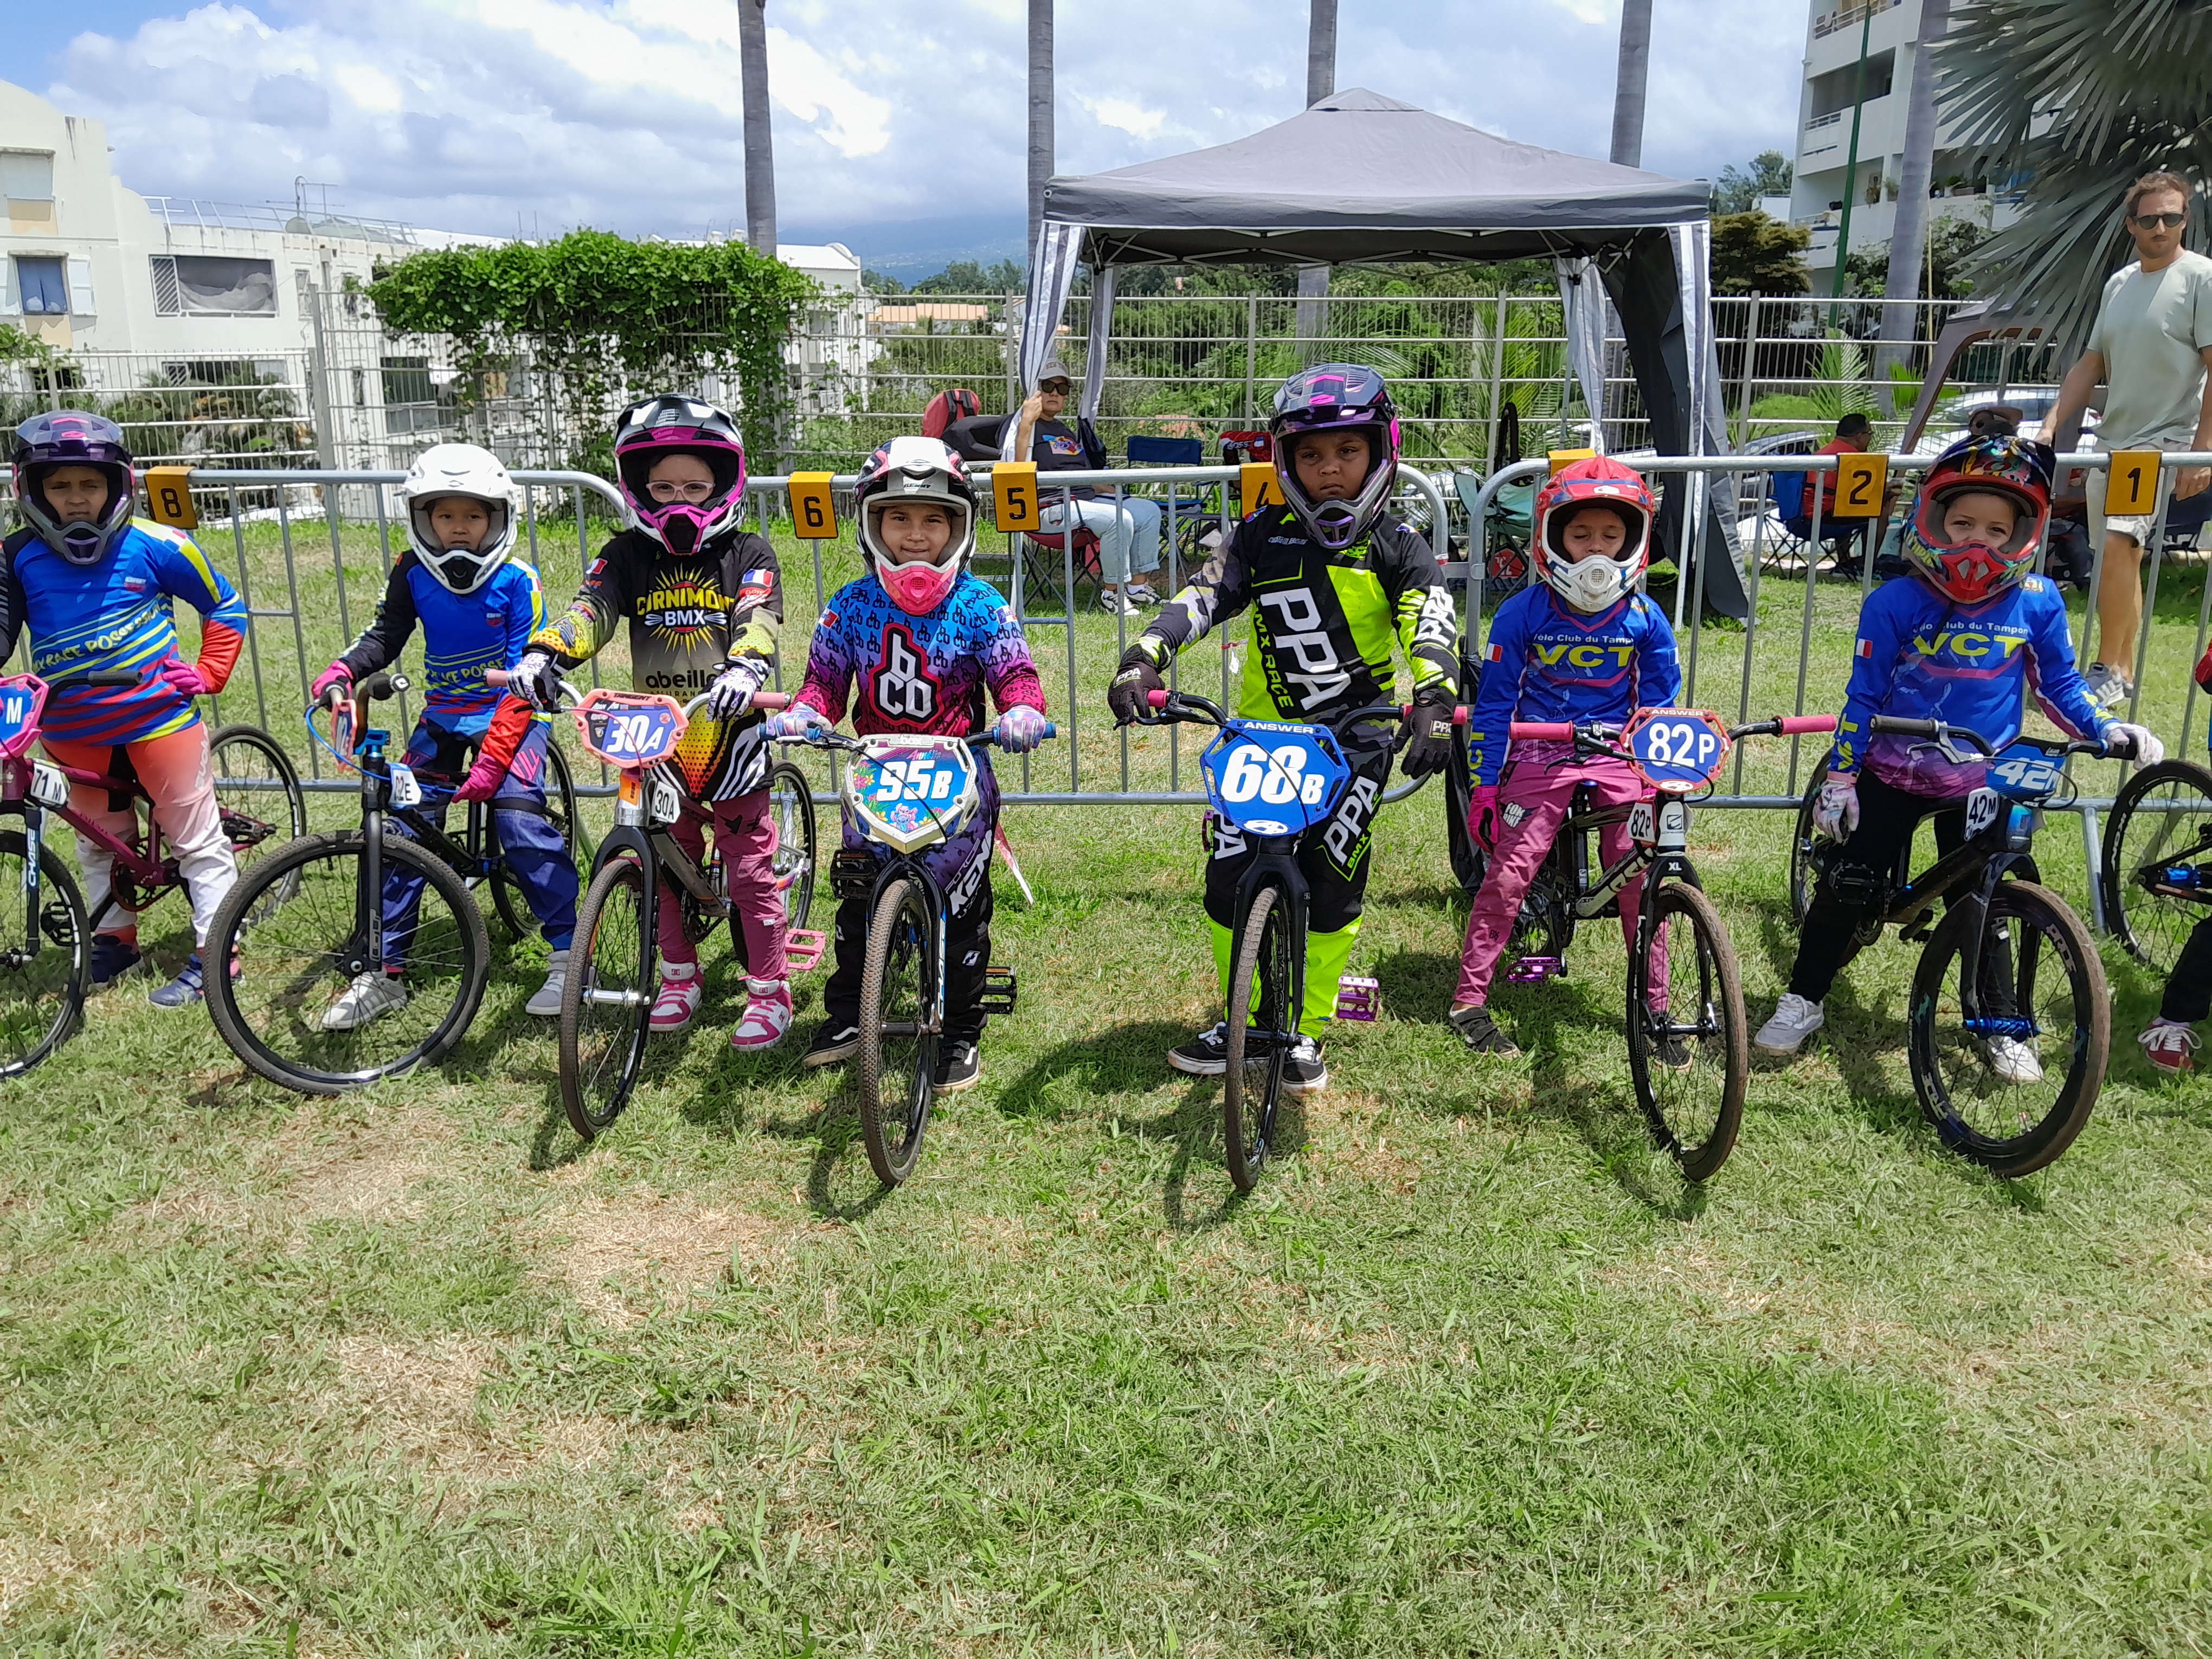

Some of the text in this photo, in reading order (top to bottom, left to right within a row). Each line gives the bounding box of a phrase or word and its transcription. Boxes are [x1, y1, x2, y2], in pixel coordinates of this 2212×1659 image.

[1849, 470, 1872, 505] 2
[2127, 466, 2140, 503] 1
[159, 487, 182, 518] 8
[803, 496, 824, 527] 6
[1007, 487, 1026, 520] 5
[665, 609, 705, 626] BMX
[1945, 621, 1965, 629] lub
[1968, 621, 1983, 630] du
[1260, 587, 1352, 711] PPA
[1532, 644, 1635, 667] VCT
[1602, 635, 1634, 645] Tamp
[1913, 632, 2027, 658] VCT
[1116, 667, 1141, 682] PPA
[1264, 654, 1295, 709] RACE
[6, 697, 22, 724] M
[614, 692, 652, 701] TANGENT
[1244, 722, 1314, 734] ANSWER
[1214, 805, 1248, 860] PA
[1323, 775, 1379, 866] PPA
[28, 827, 36, 887] CHASE
[1347, 833, 1369, 869] BMX
[1668, 862, 1682, 871] XL
[949, 829, 993, 917] KEN
